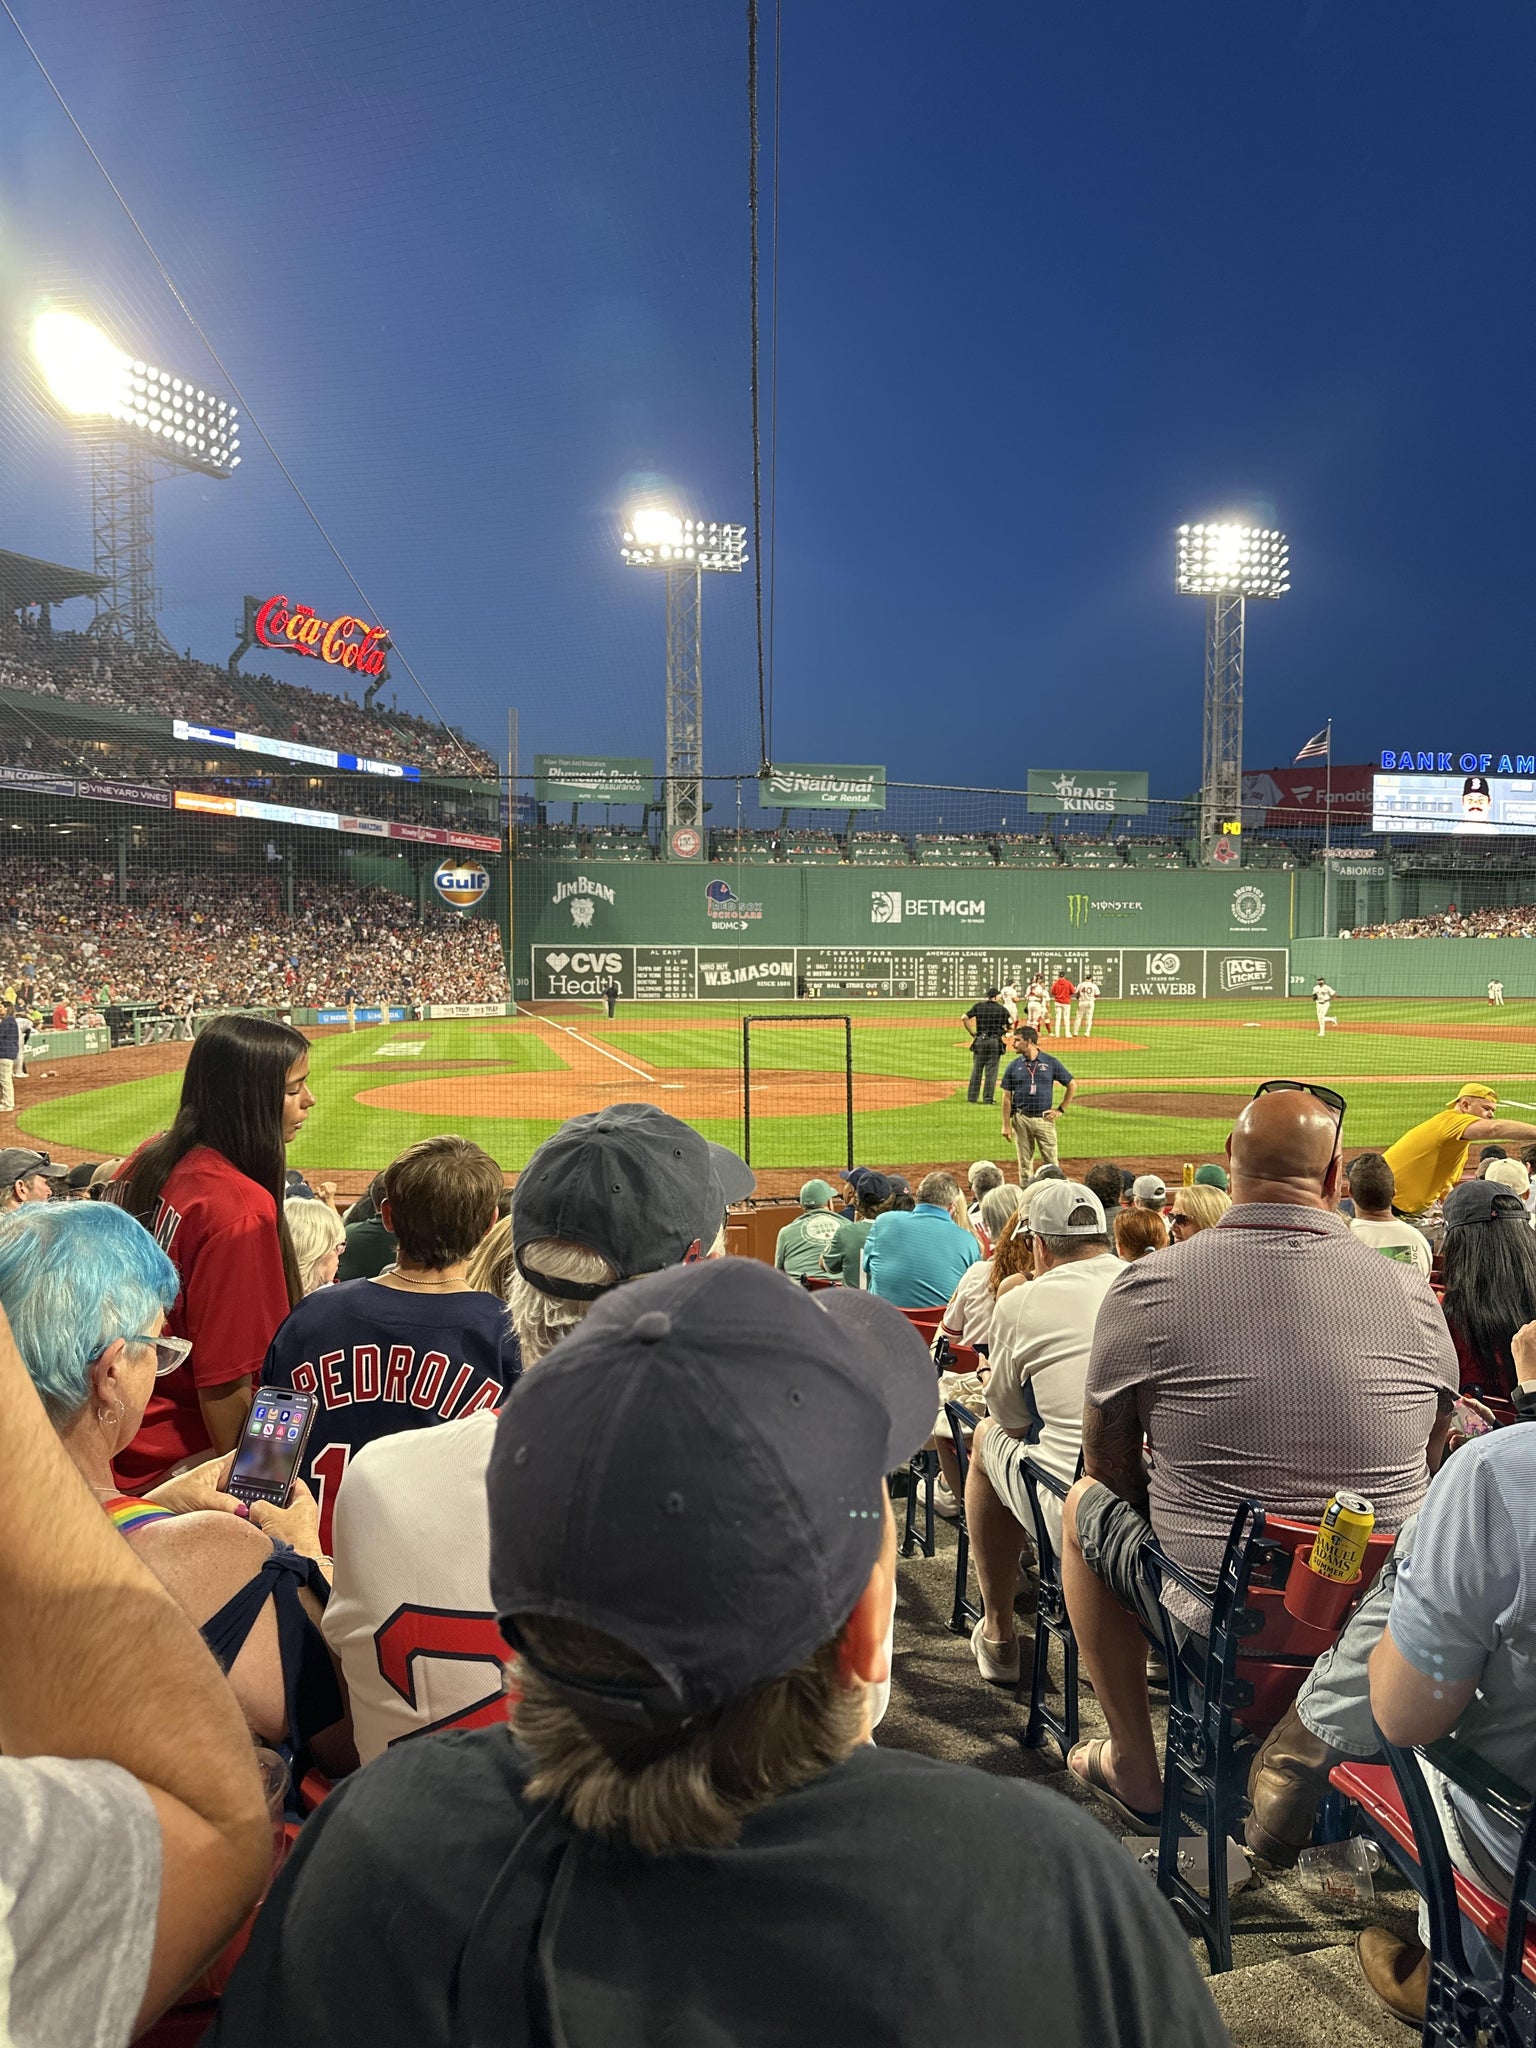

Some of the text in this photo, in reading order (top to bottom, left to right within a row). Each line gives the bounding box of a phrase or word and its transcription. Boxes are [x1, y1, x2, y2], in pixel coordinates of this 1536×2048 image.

[256, 594, 387, 676] Coca-Cola
[1381, 750, 1535, 774] BANK OF AM
[793, 774, 872, 793] National
[89, 782, 168, 802] VINEYARD VINES
[821, 793, 870, 802] Car Rental
[1060, 787, 1117, 799] DRAFT
[1063, 799, 1116, 811] KINGS
[1340, 866, 1385, 876] ABIOMED
[437, 873, 485, 889] Gulf
[905, 900, 985, 916] BETMGM
[1091, 901, 1143, 910] MONSTER
[712, 911, 762, 919] SCHOLARS
[712, 921, 739, 930] BIDMC
[571, 952, 623, 973] CVS
[1145, 953, 1180, 975] 160
[1230, 959, 1267, 974] ACE
[516, 978, 529, 986] 310
[549, 975, 623, 995] Health
[1231, 972, 1267, 984] TICKET
[1081, 987, 1093, 995] 40
[1129, 983, 1196, 996] F.W. WEBB
[291, 1343, 504, 1420] PEDROIA
[1316, 1532, 1357, 1562] SAMUEL
[1313, 1556, 1344, 1577] SUMMER
[1314, 1545, 1350, 1572] ADAMS
